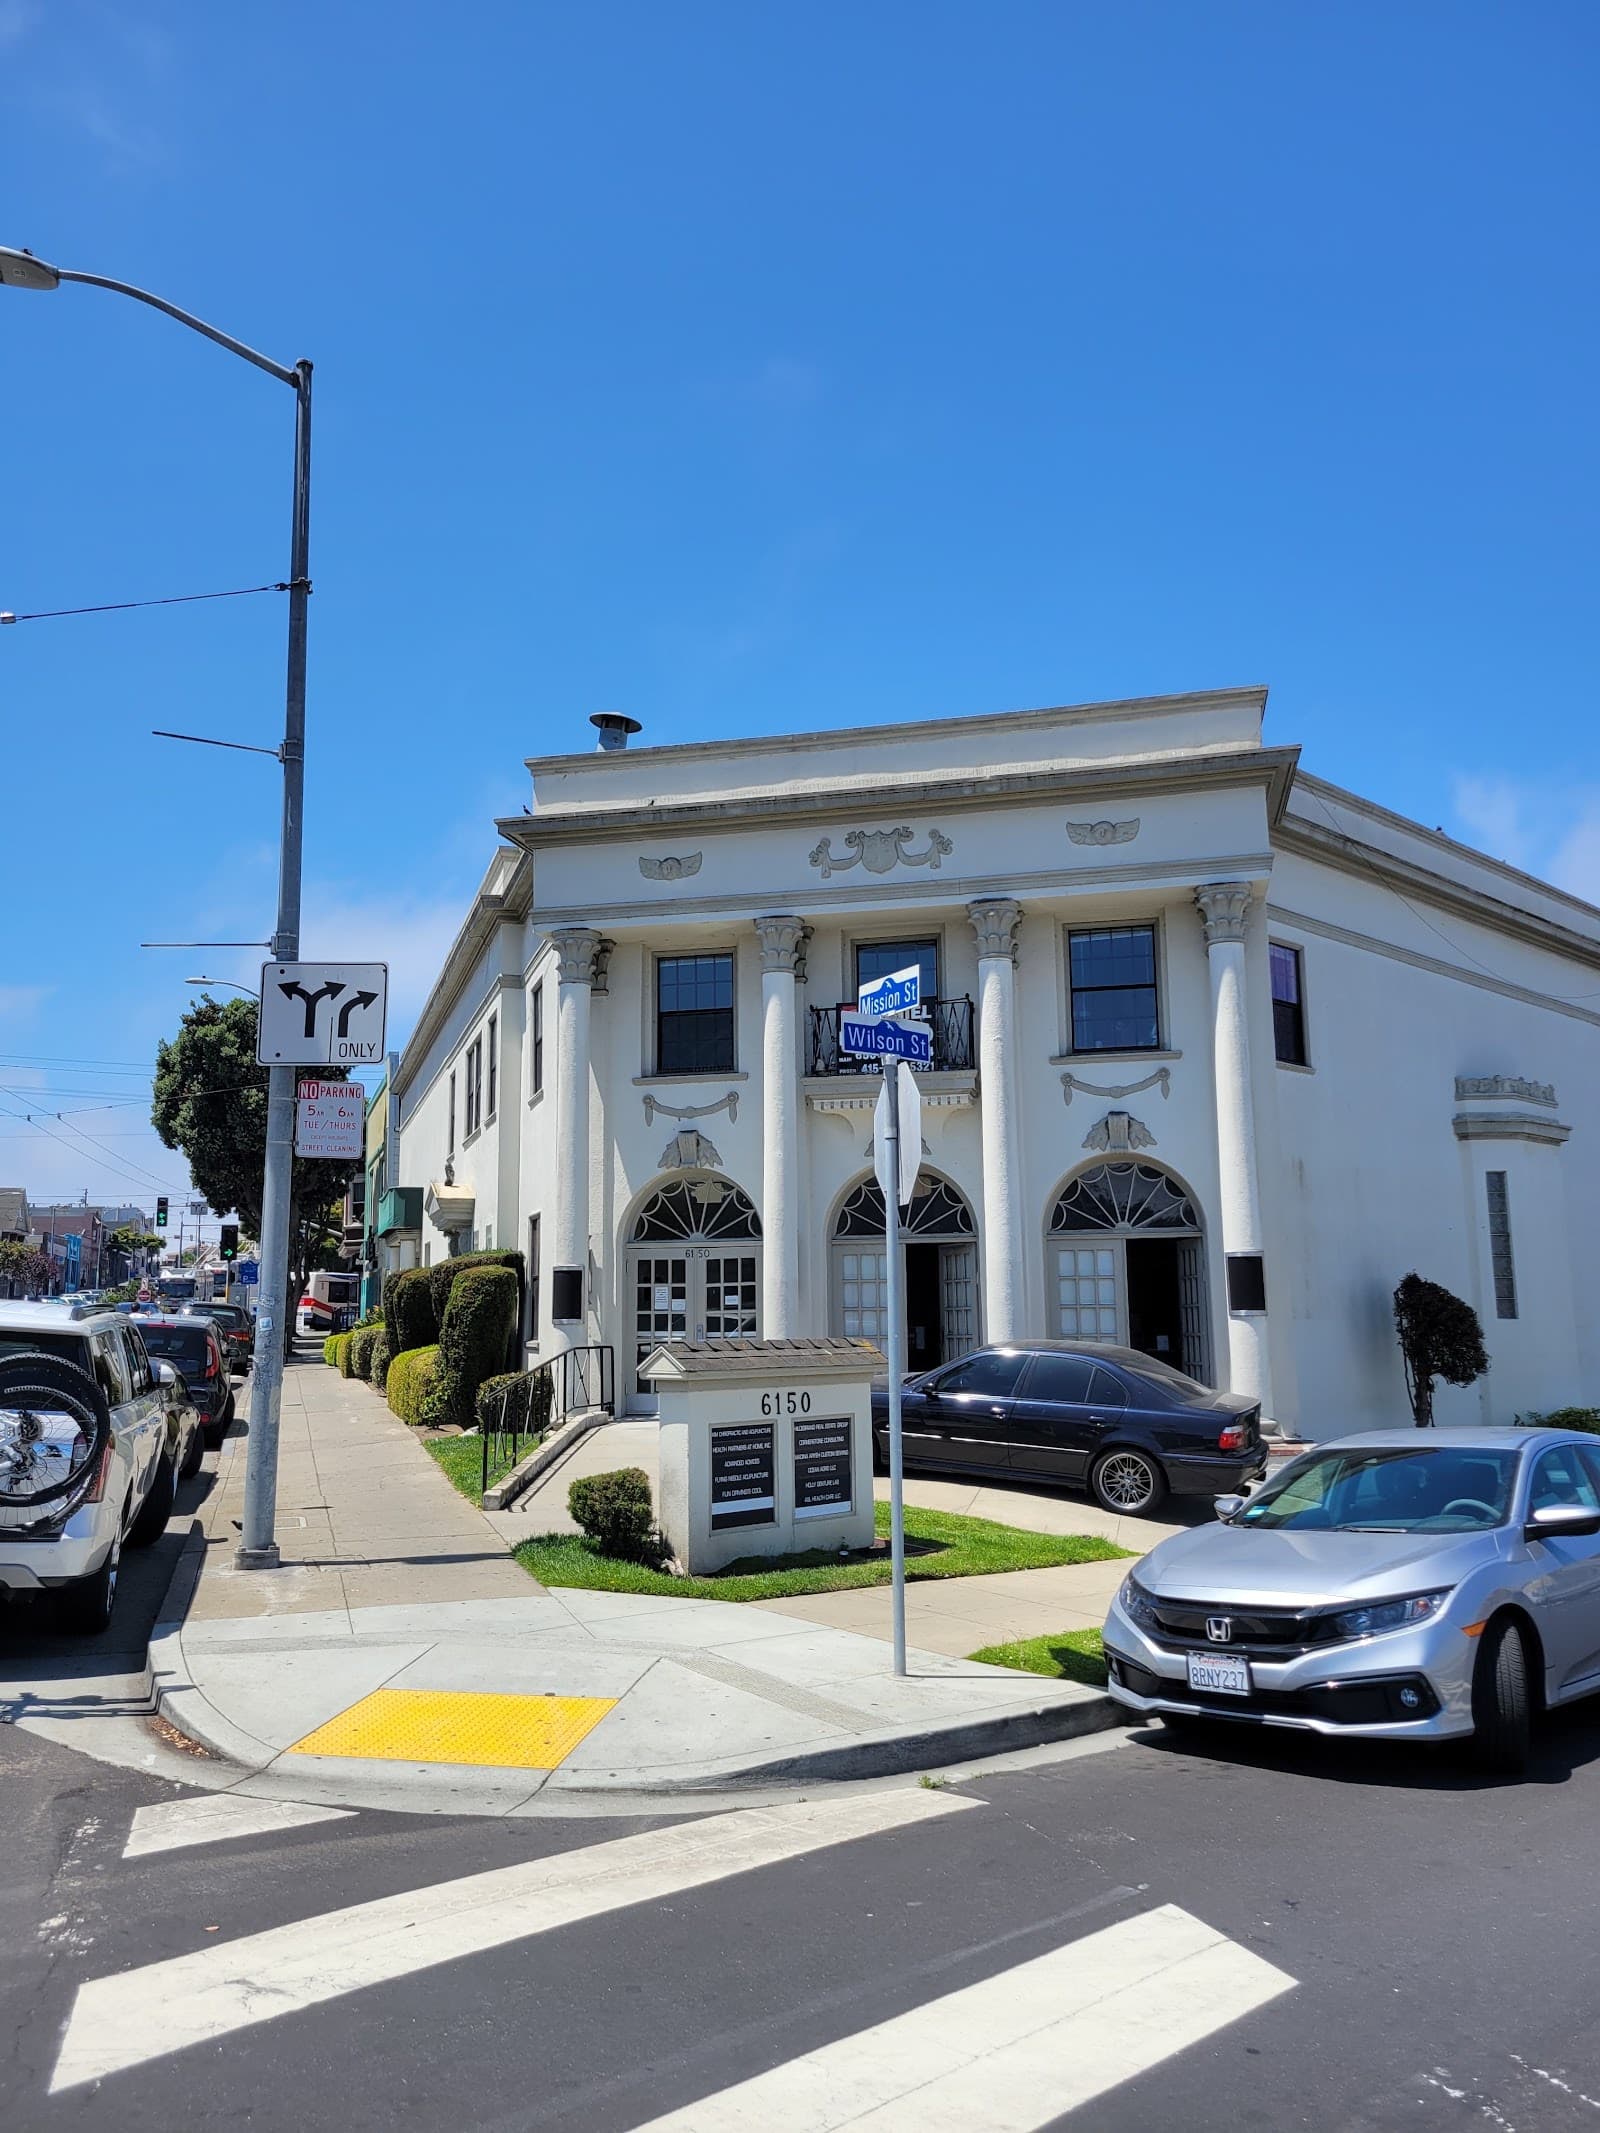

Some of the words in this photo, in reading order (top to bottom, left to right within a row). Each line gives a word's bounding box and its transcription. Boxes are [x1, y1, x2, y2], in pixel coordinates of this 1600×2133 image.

[861, 991, 900, 1015] Mission
[905, 982, 917, 1003] St
[338, 1042, 376, 1058] ONLY
[847, 1026, 904, 1053] Wilson
[911, 1034, 927, 1057] St
[300, 1083, 318, 1099] NO
[320, 1086, 361, 1099] PARKING
[302, 1144, 323, 1152] STREET
[327, 1145, 357, 1153] CLEANING
[761, 1391, 811, 1415] 6150
[1191, 1666, 1245, 1689] 8RNY237
